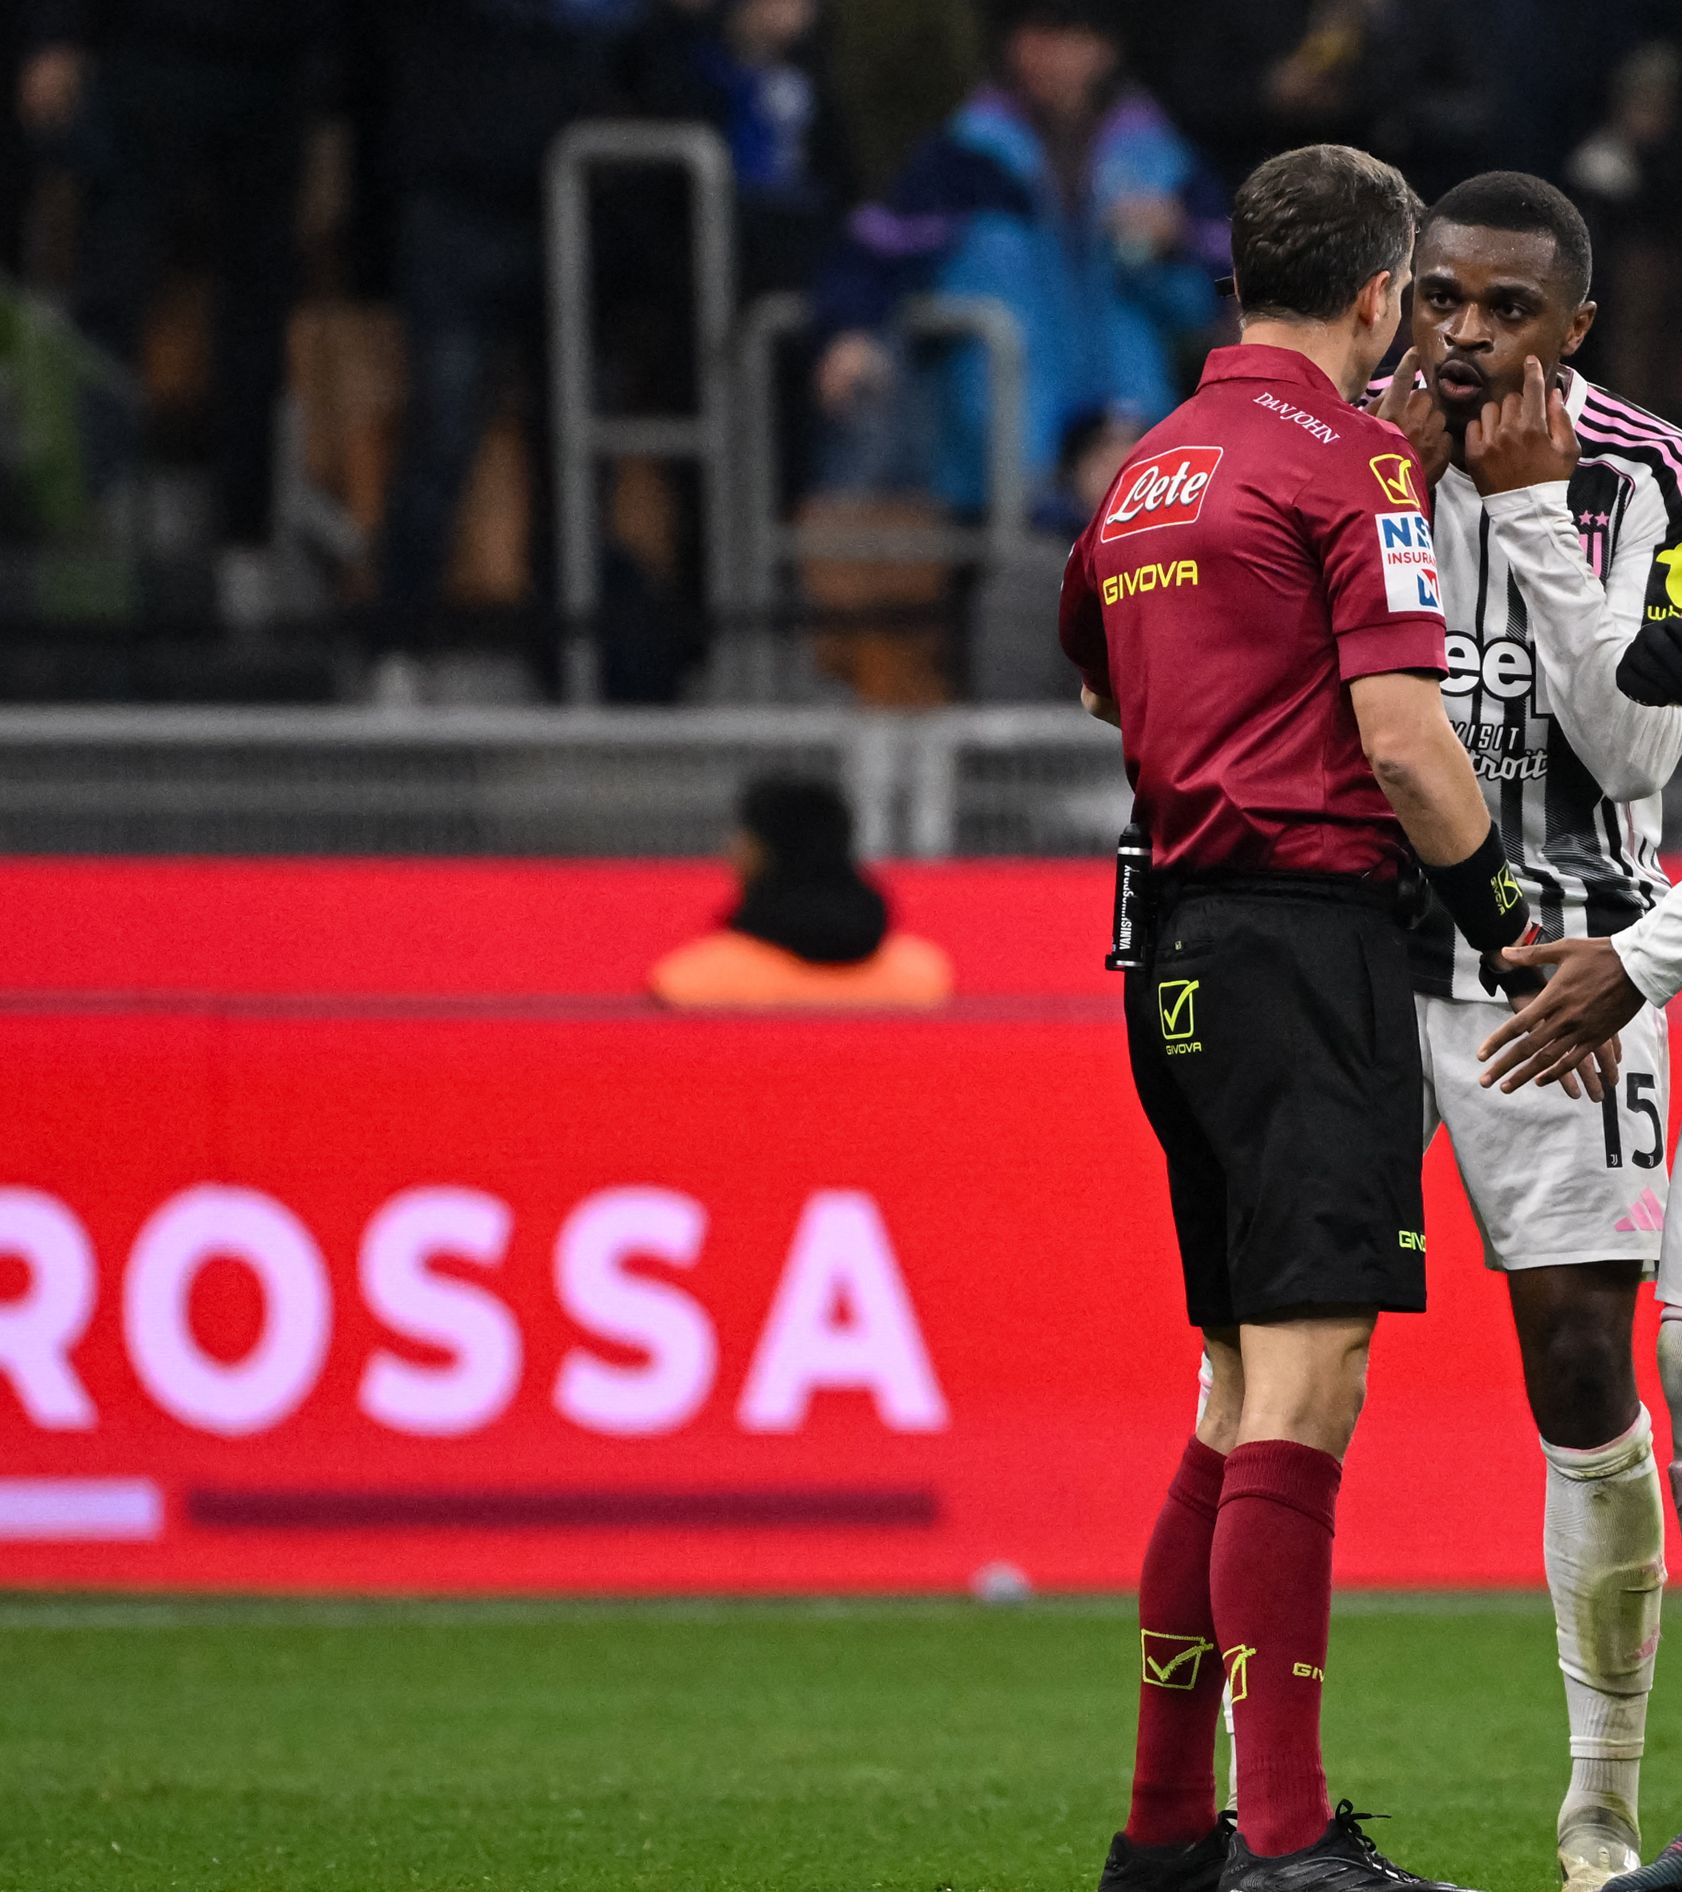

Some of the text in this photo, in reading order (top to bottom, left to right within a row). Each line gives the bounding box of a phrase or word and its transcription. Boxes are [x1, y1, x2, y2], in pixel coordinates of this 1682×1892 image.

[1253, 391, 1341, 444] DAN JOHN
[1105, 461, 1208, 525] Lete
[1102, 559, 1199, 606] GIVOVA
[1440, 630, 1554, 718] ee
[1470, 749, 1548, 780] troit
[1597, 1072, 1664, 1169] 15
